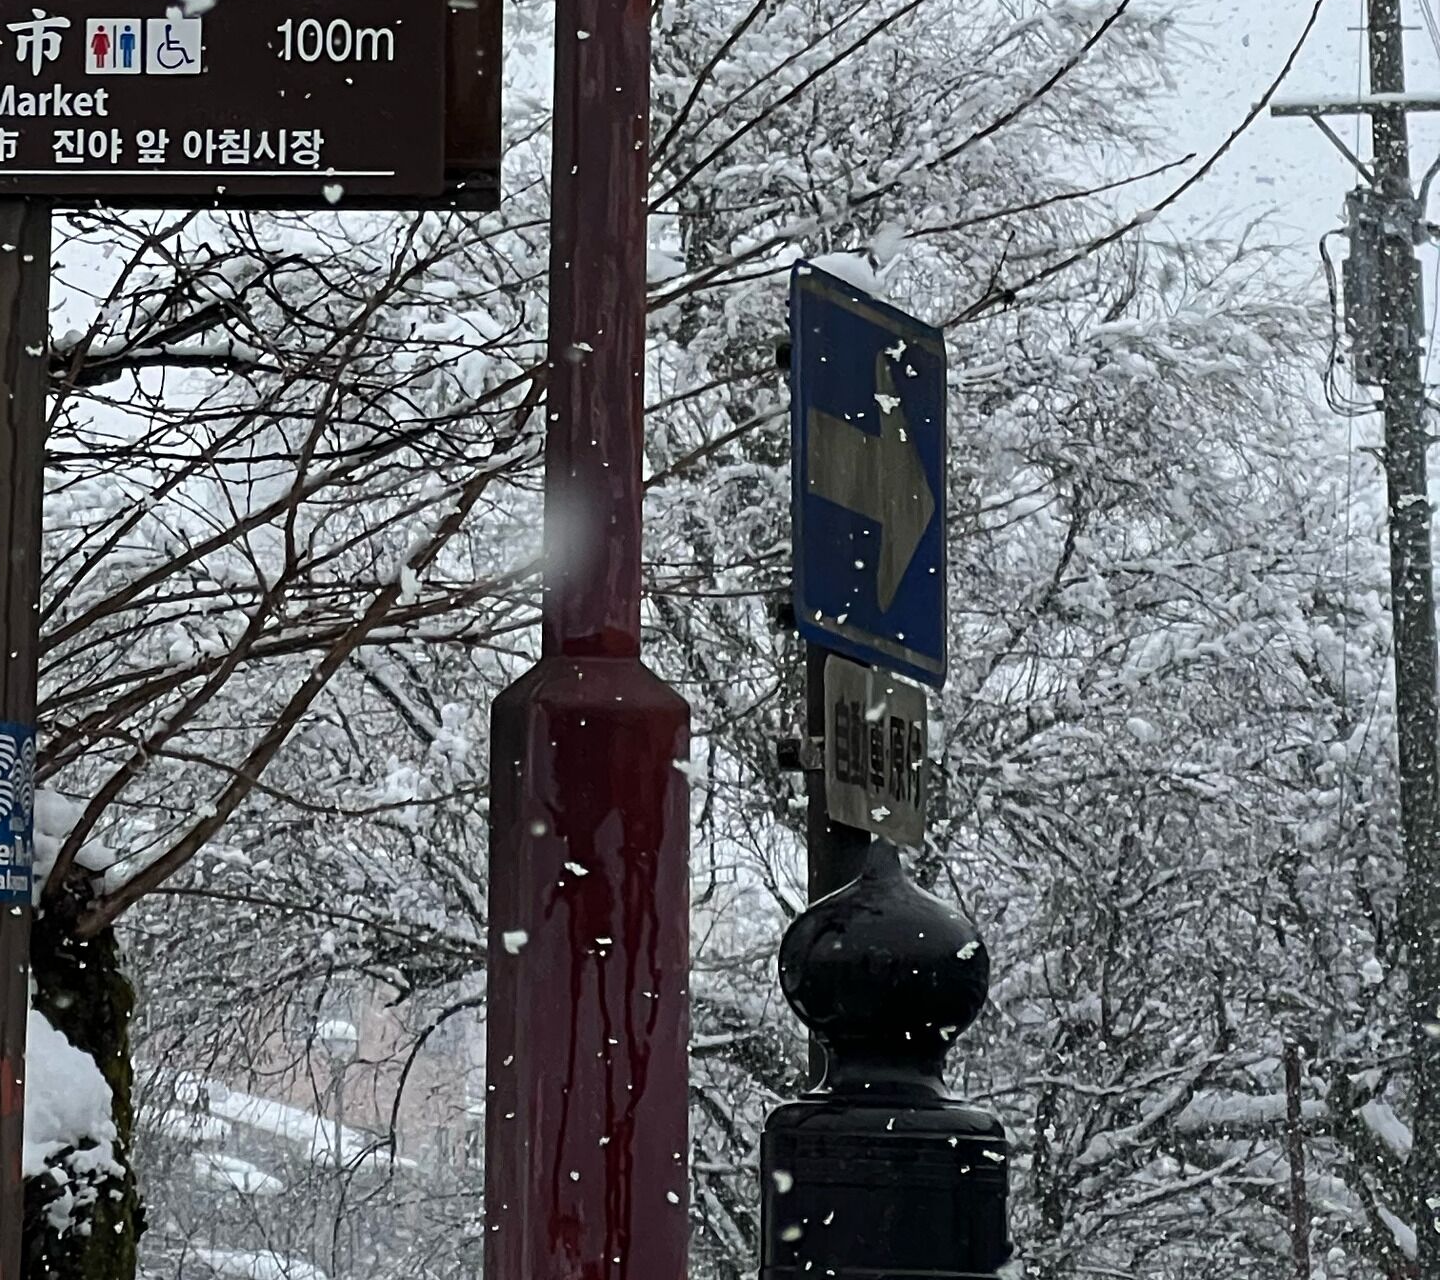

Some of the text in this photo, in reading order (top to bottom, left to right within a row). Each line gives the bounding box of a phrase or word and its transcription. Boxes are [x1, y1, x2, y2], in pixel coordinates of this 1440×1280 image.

[276, 18, 394, 62] 100m
[52, 129, 123, 164] 진야
[136, 129, 168, 164] 앞
[183, 128, 324, 165] 아침시장
